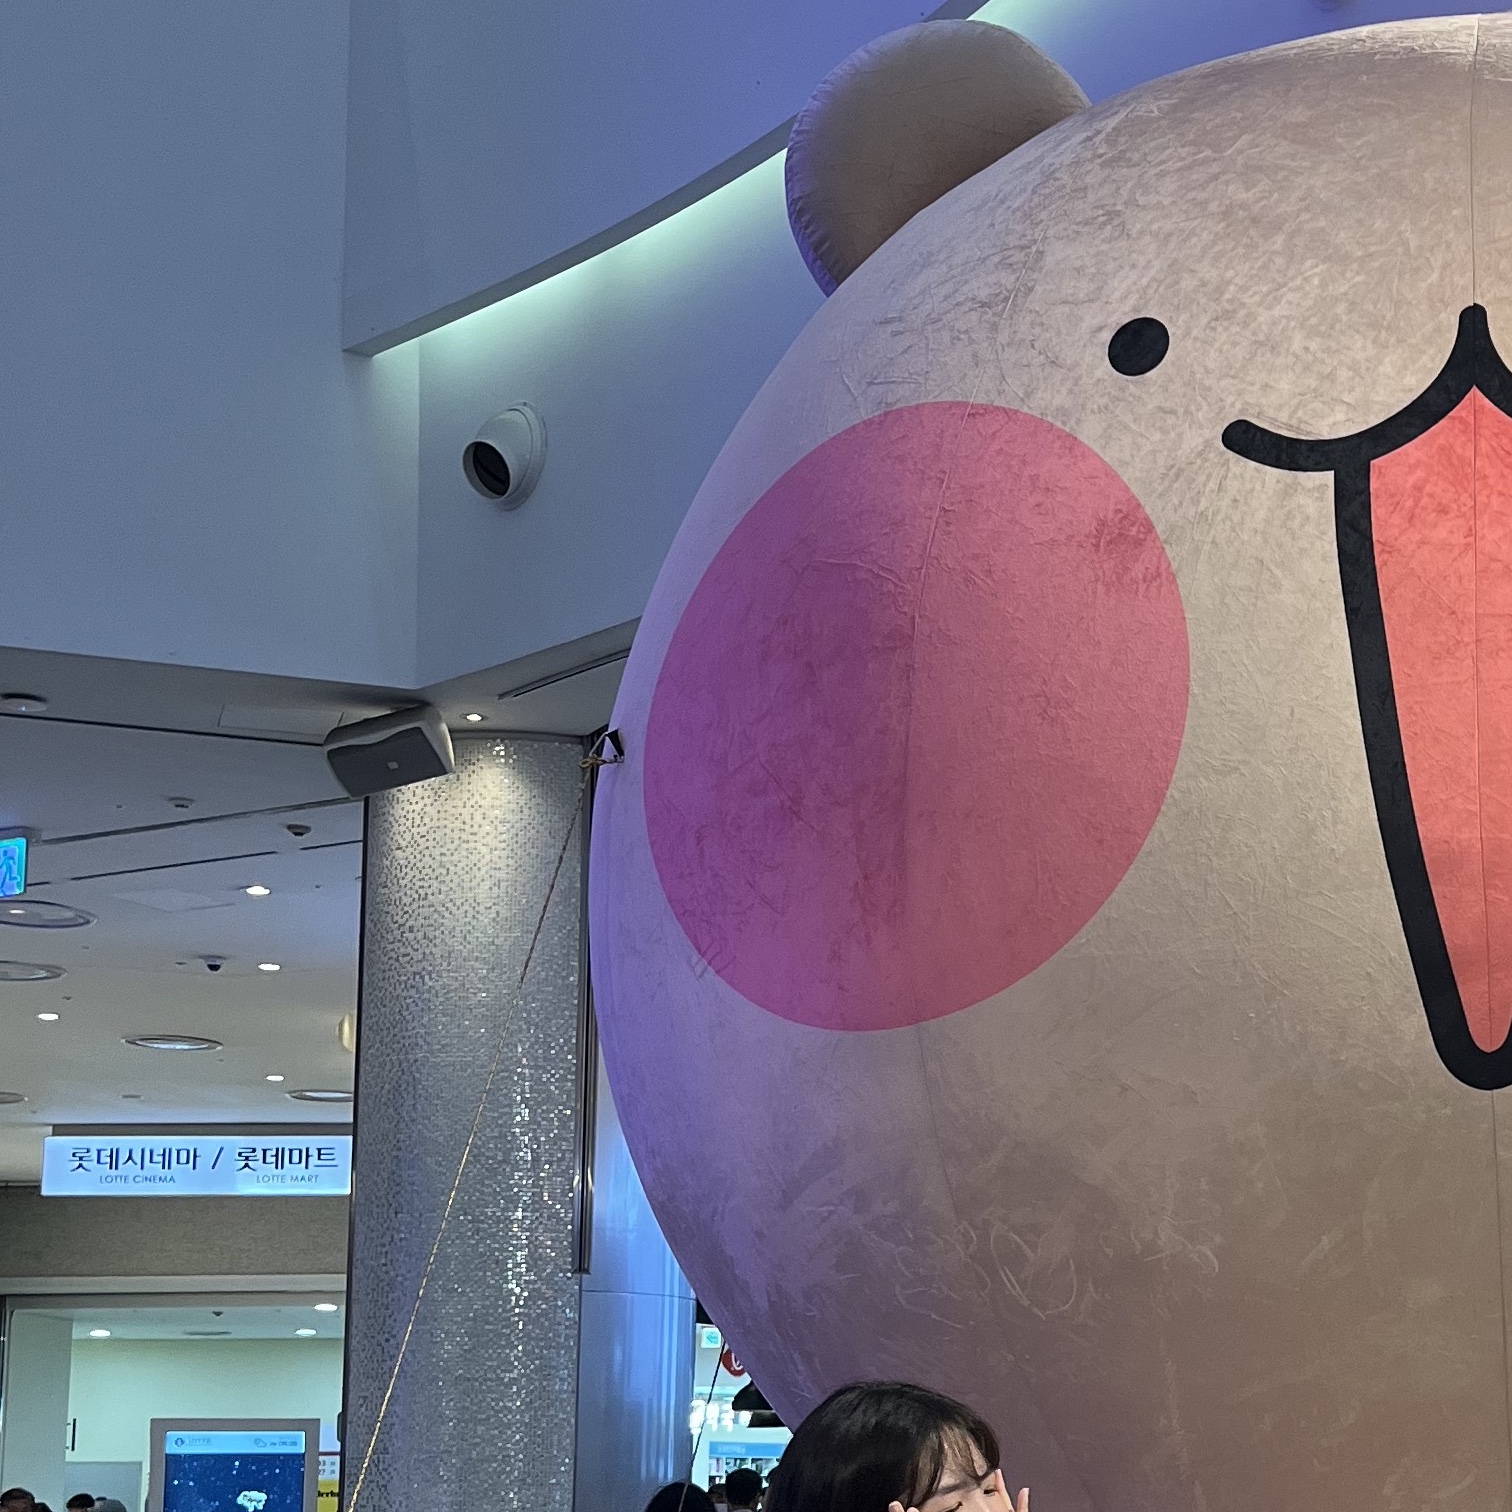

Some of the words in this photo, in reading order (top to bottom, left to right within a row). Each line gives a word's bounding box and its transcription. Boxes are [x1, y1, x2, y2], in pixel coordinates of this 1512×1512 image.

[68, 1147, 201, 1172] 롯데시네마
[234, 1147, 339, 1172] 롯데마트
[100, 1175, 129, 1184] LOTTE
[133, 1175, 176, 1184] CINEMA
[256, 1175, 286, 1184] LOTTE
[290, 1174, 319, 1183] MART
